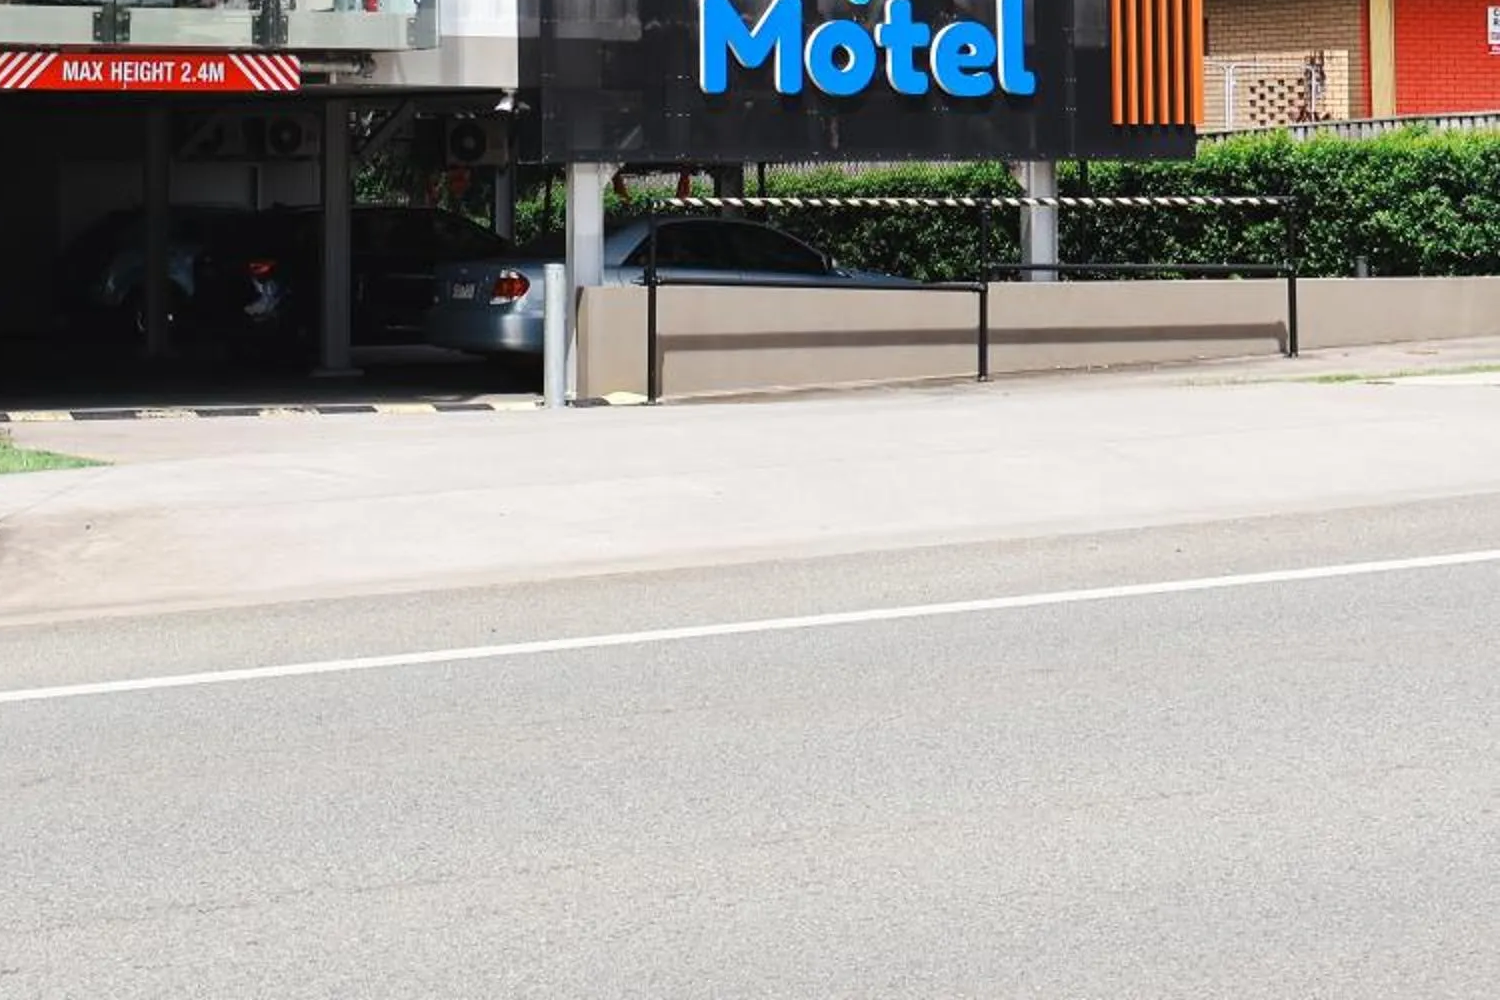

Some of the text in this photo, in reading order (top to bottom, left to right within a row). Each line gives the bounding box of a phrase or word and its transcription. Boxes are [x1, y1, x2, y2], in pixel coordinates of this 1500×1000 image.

[62, 60, 225, 83] MAX HEIGHT 2.4M
